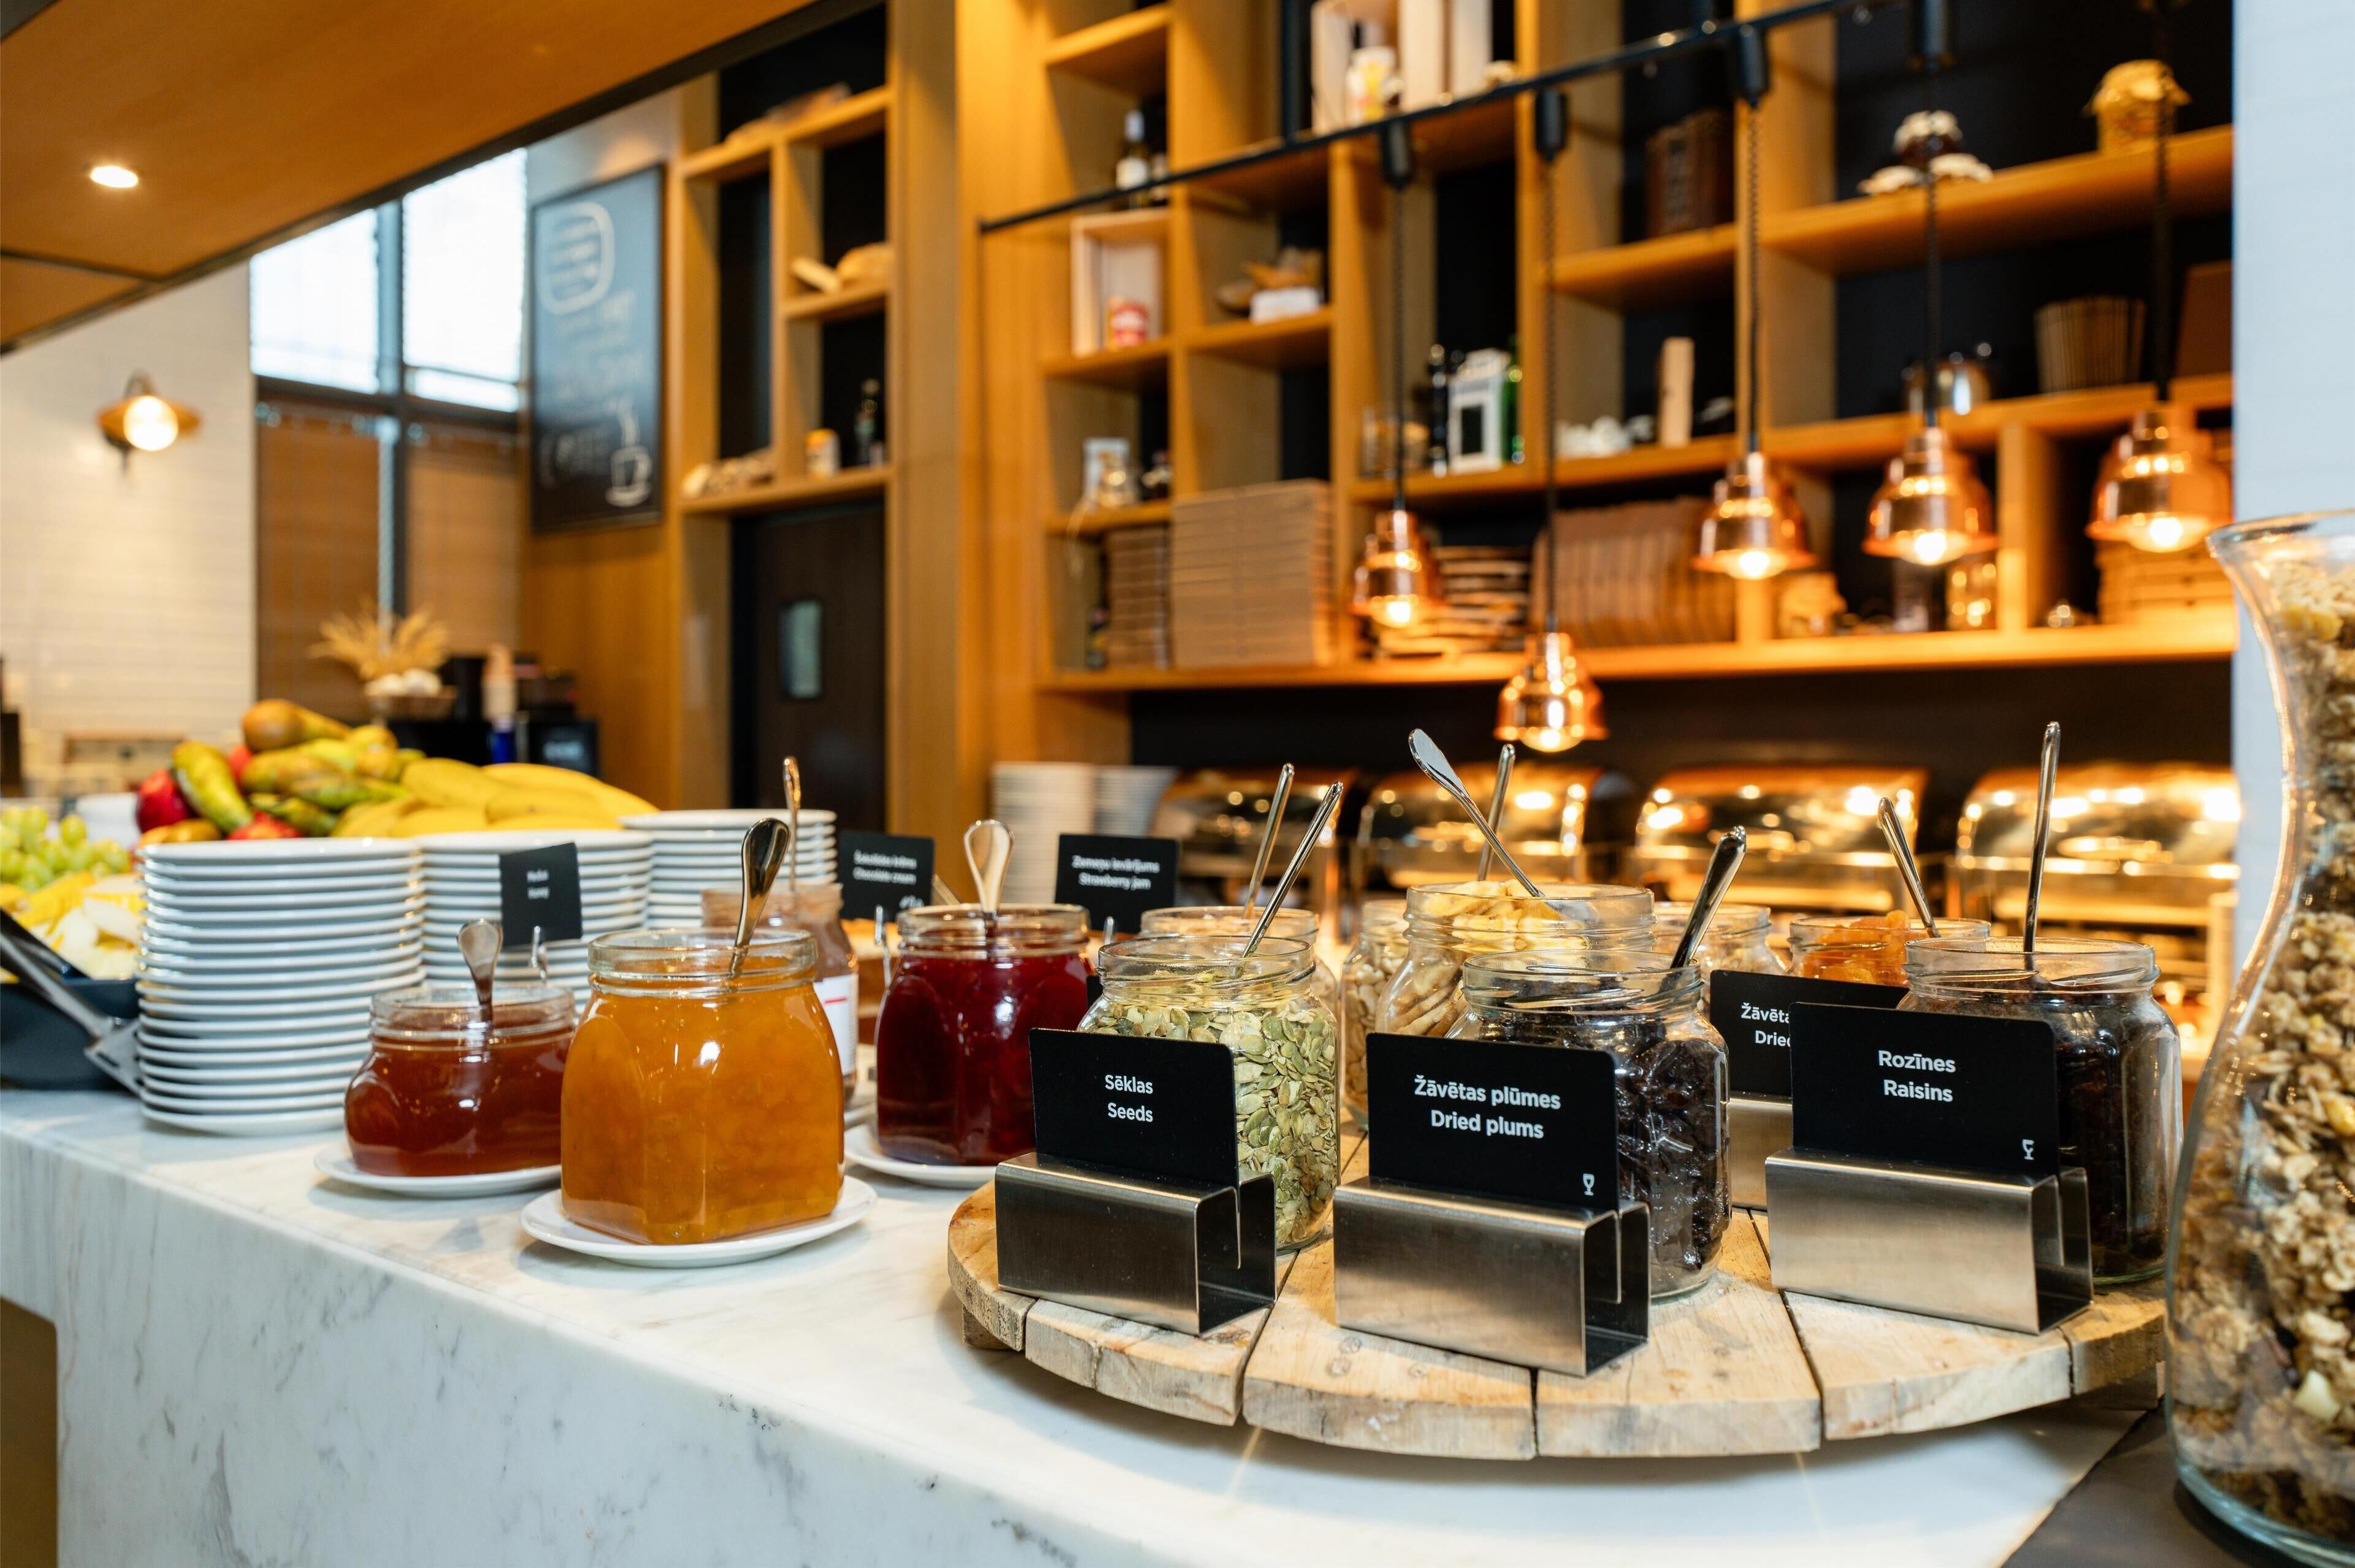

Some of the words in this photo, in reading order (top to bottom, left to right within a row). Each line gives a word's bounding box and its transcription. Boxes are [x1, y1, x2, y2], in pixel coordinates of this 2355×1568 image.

[1079, 872, 1130, 890] Strawberry
[1130, 875, 1151, 891] jam
[1878, 1050, 1956, 1073] Rozīnes
[1105, 1074, 1154, 1095] Sēklas
[1414, 1074, 1487, 1102] Žāvētas
[1491, 1086, 1561, 1110] plūmes
[1883, 1079, 1953, 1103] Raisins
[1108, 1102, 1154, 1122] Seeds
[1431, 1109, 1481, 1132] Dried
[1486, 1116, 1544, 1139] plums
